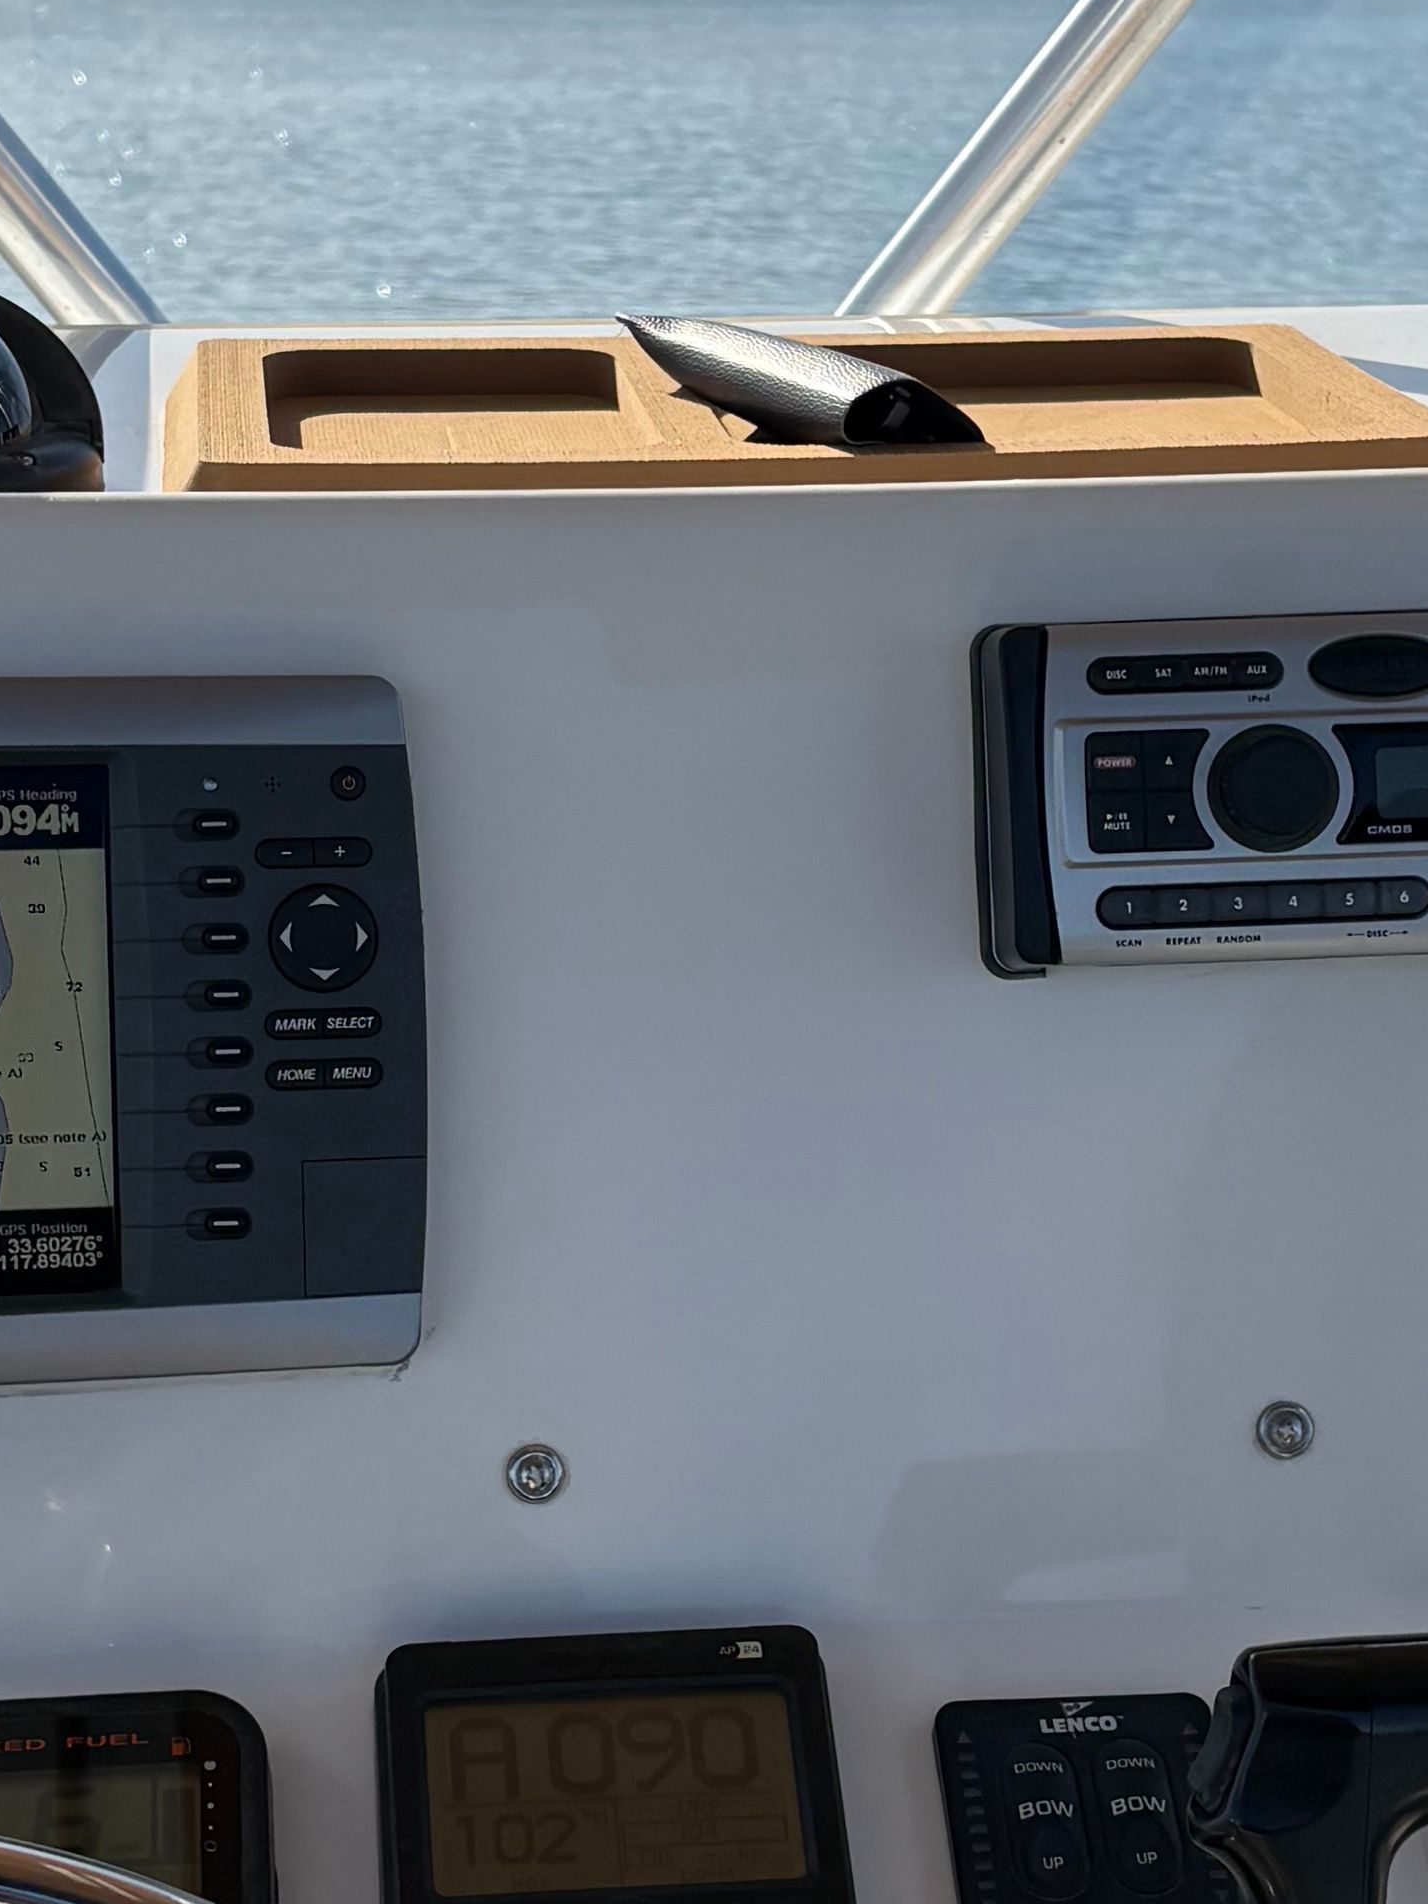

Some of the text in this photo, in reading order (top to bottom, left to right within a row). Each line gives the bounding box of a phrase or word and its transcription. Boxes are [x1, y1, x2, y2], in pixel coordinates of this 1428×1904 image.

[1105, 669, 1128, 681] DISC
[1155, 667, 1172, 679] SAT
[1246, 664, 1268, 675] AUX
[1097, 758, 1133, 768] POWER
[20, 788, 77, 802] Heading
[1104, 820, 1131, 832] MUTE
[1288, 895, 1299, 908] 4
[1345, 893, 1355, 906] 5
[1399, 890, 1410, 903] 6
[1126, 901, 1133, 914] 1
[1179, 899, 1188, 912] 2
[1233, 897, 1243, 910] 3
[1216, 935, 1261, 944] RANDOM
[1366, 929, 1389, 938] DISC
[1116, 939, 1142, 947] SCAN
[1166, 936, 1202, 946] REPEAT
[274, 1017, 318, 1032] MARK
[325, 1015, 375, 1030] SELECT
[276, 1068, 317, 1082] HOME
[332, 1066, 372, 1080] MENU
[0, 1222, 88, 1236] GPS Position
[1039, 1715, 1118, 1735] LENCO
[63, 1732, 150, 1750] FUEL
[1013, 1761, 1064, 1775] DOWN
[1105, 1757, 1156, 1771] DOWN
[1018, 1799, 1074, 1820] BOW
[1110, 1795, 1167, 1816] BOW
[1042, 1856, 1064, 1871] UP
[1136, 1851, 1158, 1865] UP
